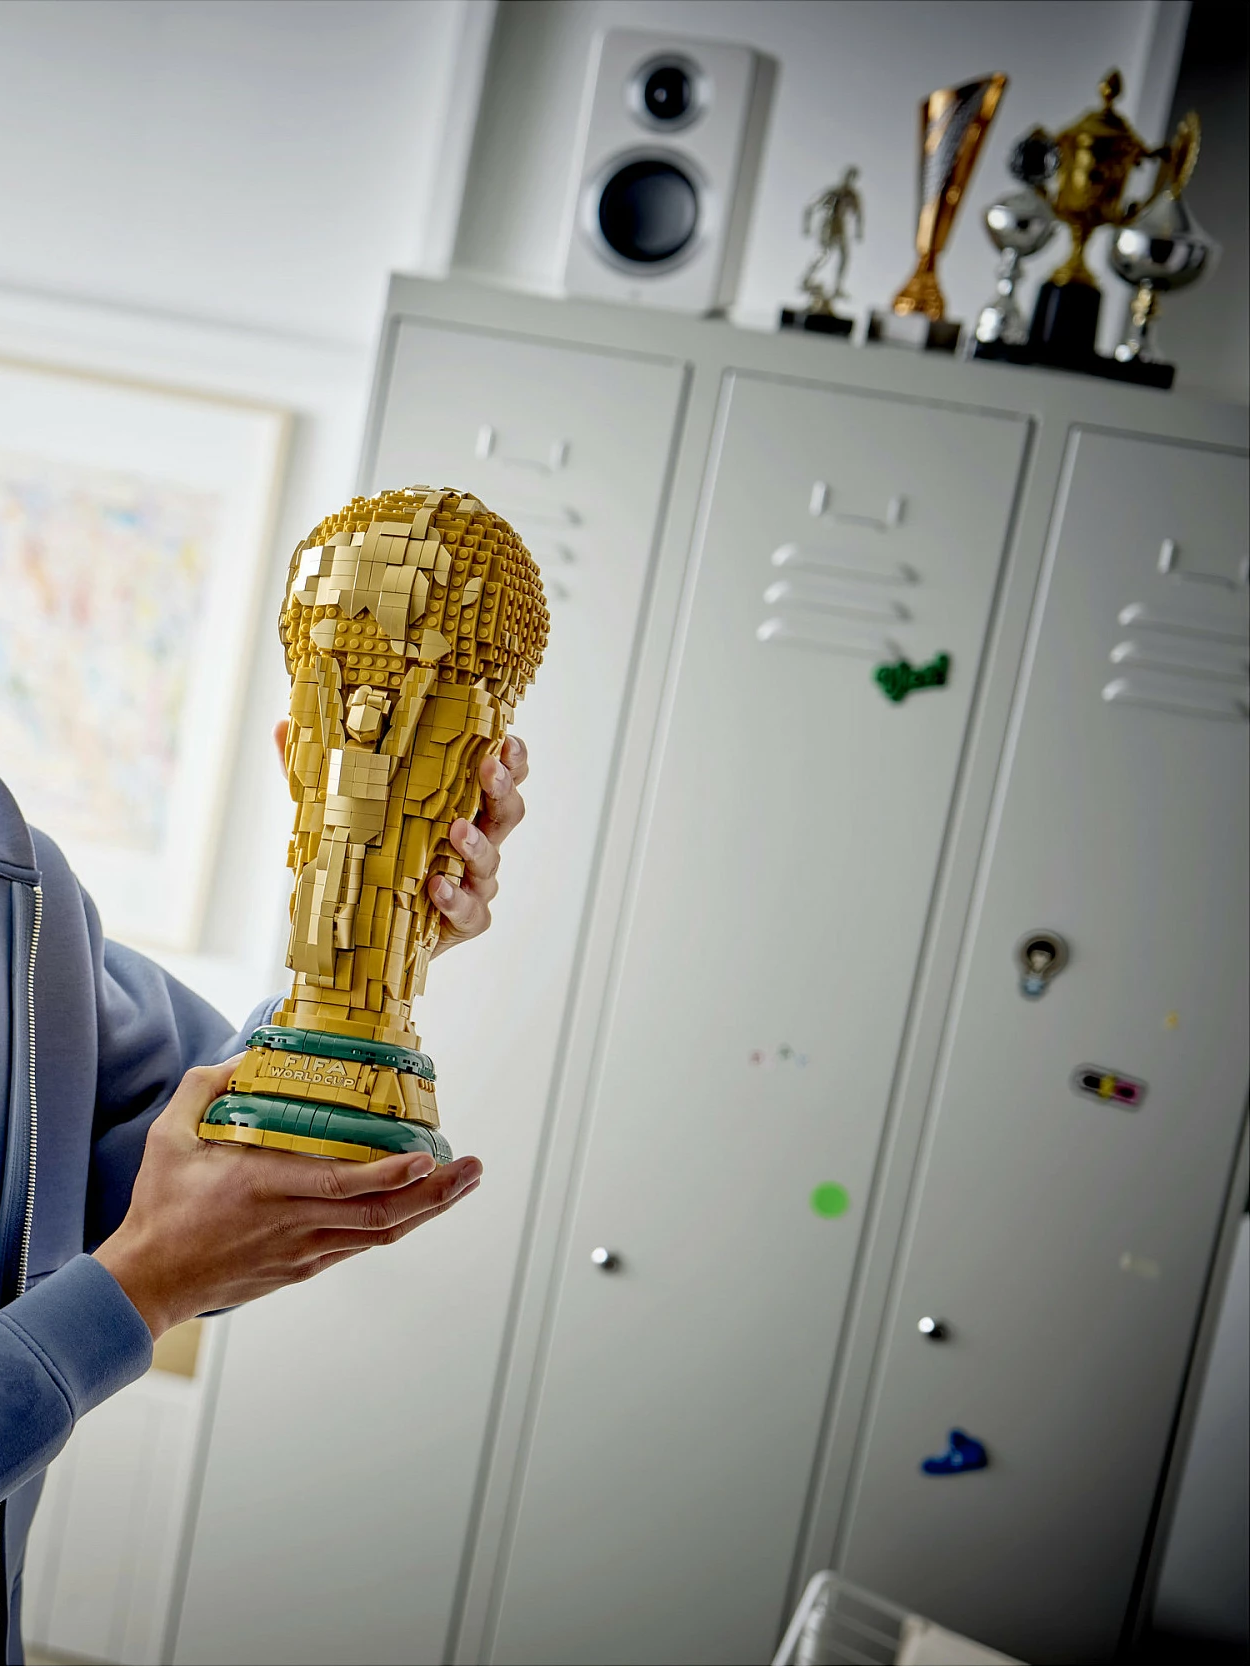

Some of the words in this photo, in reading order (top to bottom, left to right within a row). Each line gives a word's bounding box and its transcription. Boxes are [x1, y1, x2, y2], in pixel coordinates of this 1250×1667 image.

[284, 1053, 347, 1076] FIFA
[271, 1067, 322, 1083] WORLD
[324, 1076, 355, 1087] CUP
